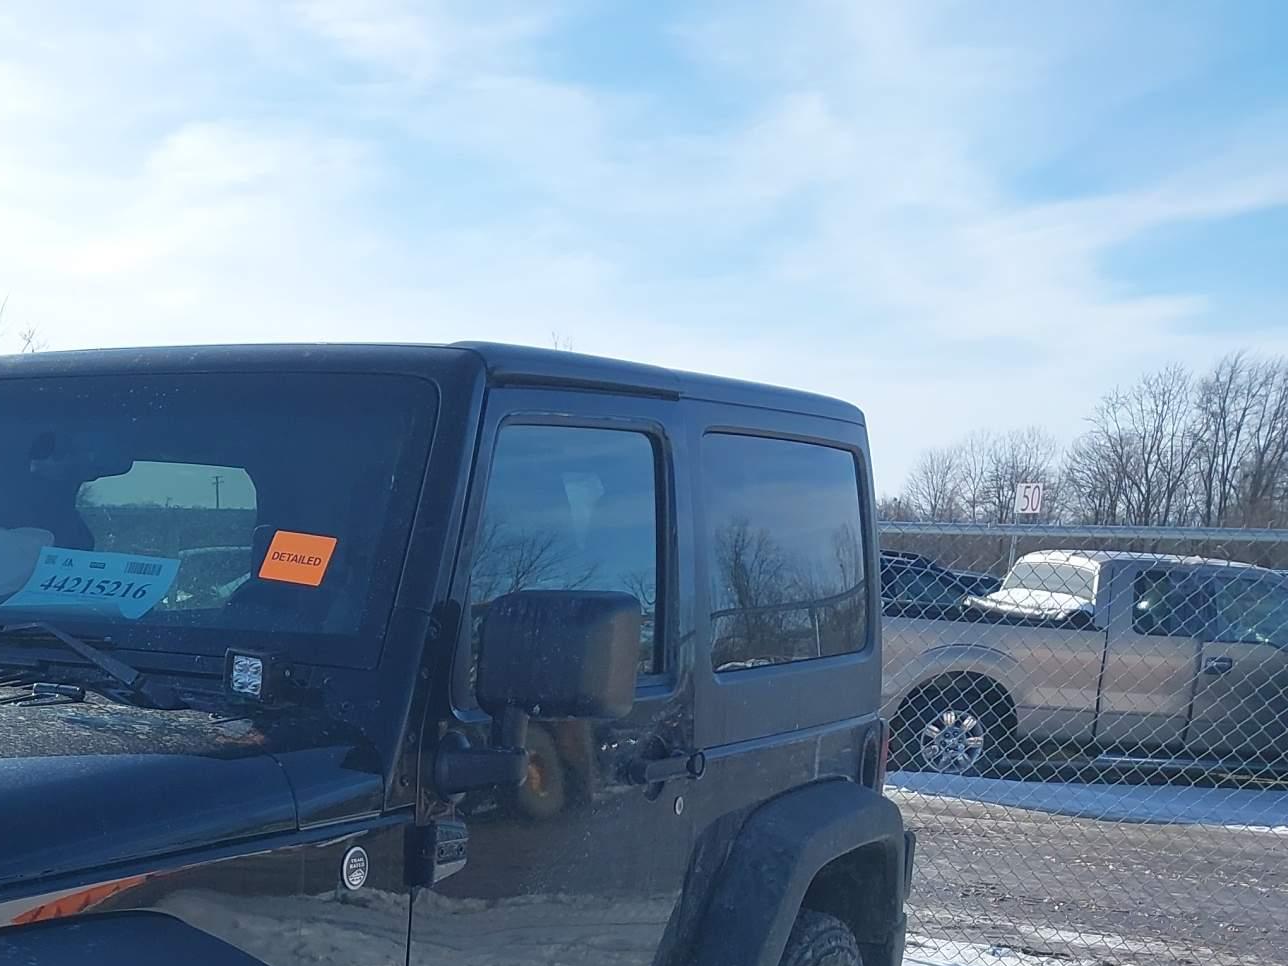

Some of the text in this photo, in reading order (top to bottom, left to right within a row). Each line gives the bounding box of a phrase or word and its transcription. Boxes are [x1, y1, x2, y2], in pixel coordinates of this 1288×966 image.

[1020, 485, 1041, 512] 50
[272, 551, 322, 567] DETAILED
[40, 575, 152, 599] 44215216
